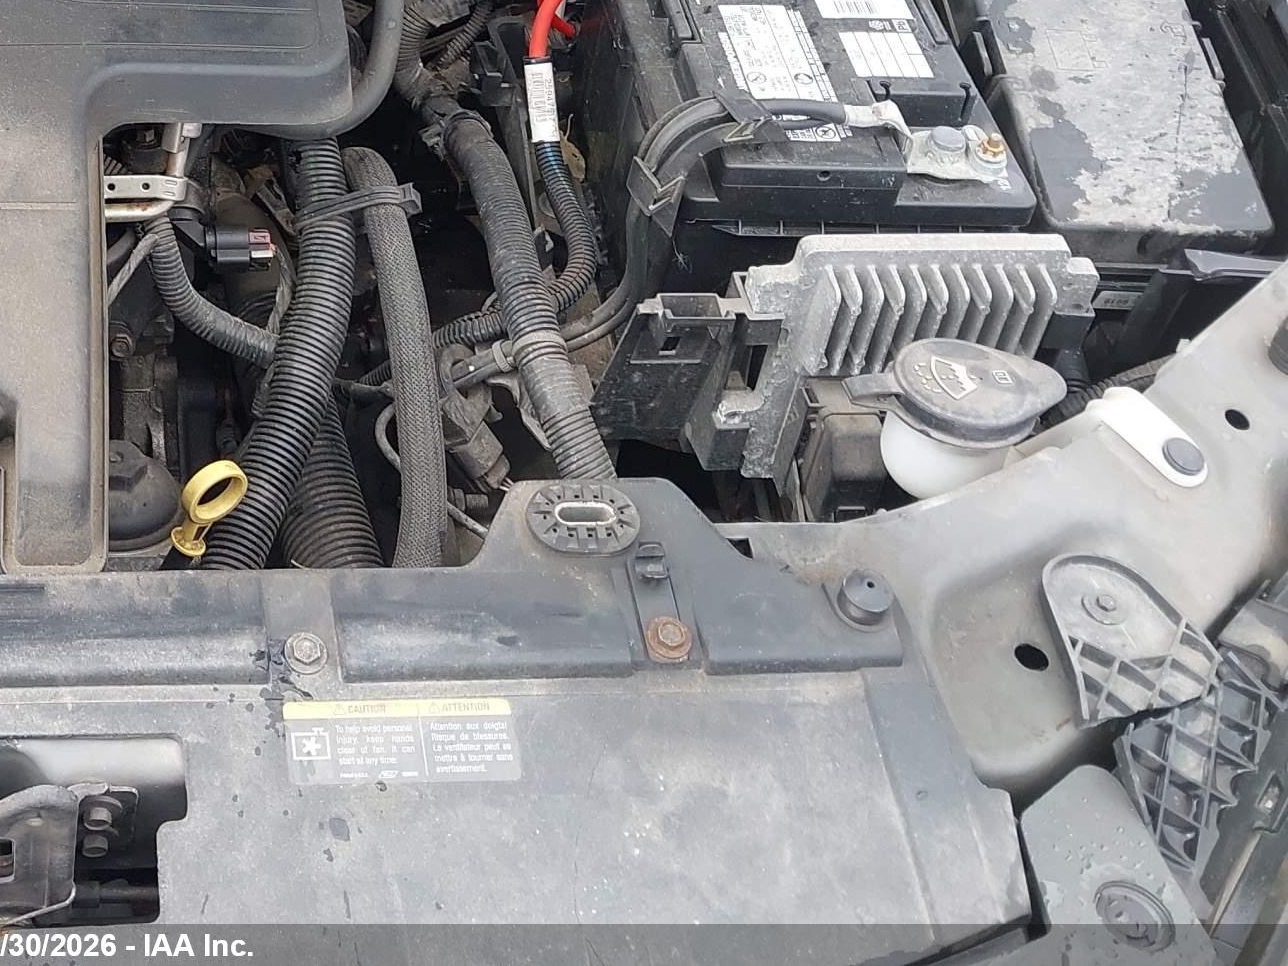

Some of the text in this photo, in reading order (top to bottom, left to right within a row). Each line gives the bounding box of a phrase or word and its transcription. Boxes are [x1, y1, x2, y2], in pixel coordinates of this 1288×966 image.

[348, 705, 386, 714] CAUTION
[441, 703, 490, 711] ATTENTION
[430, 722, 461, 730] Attention
